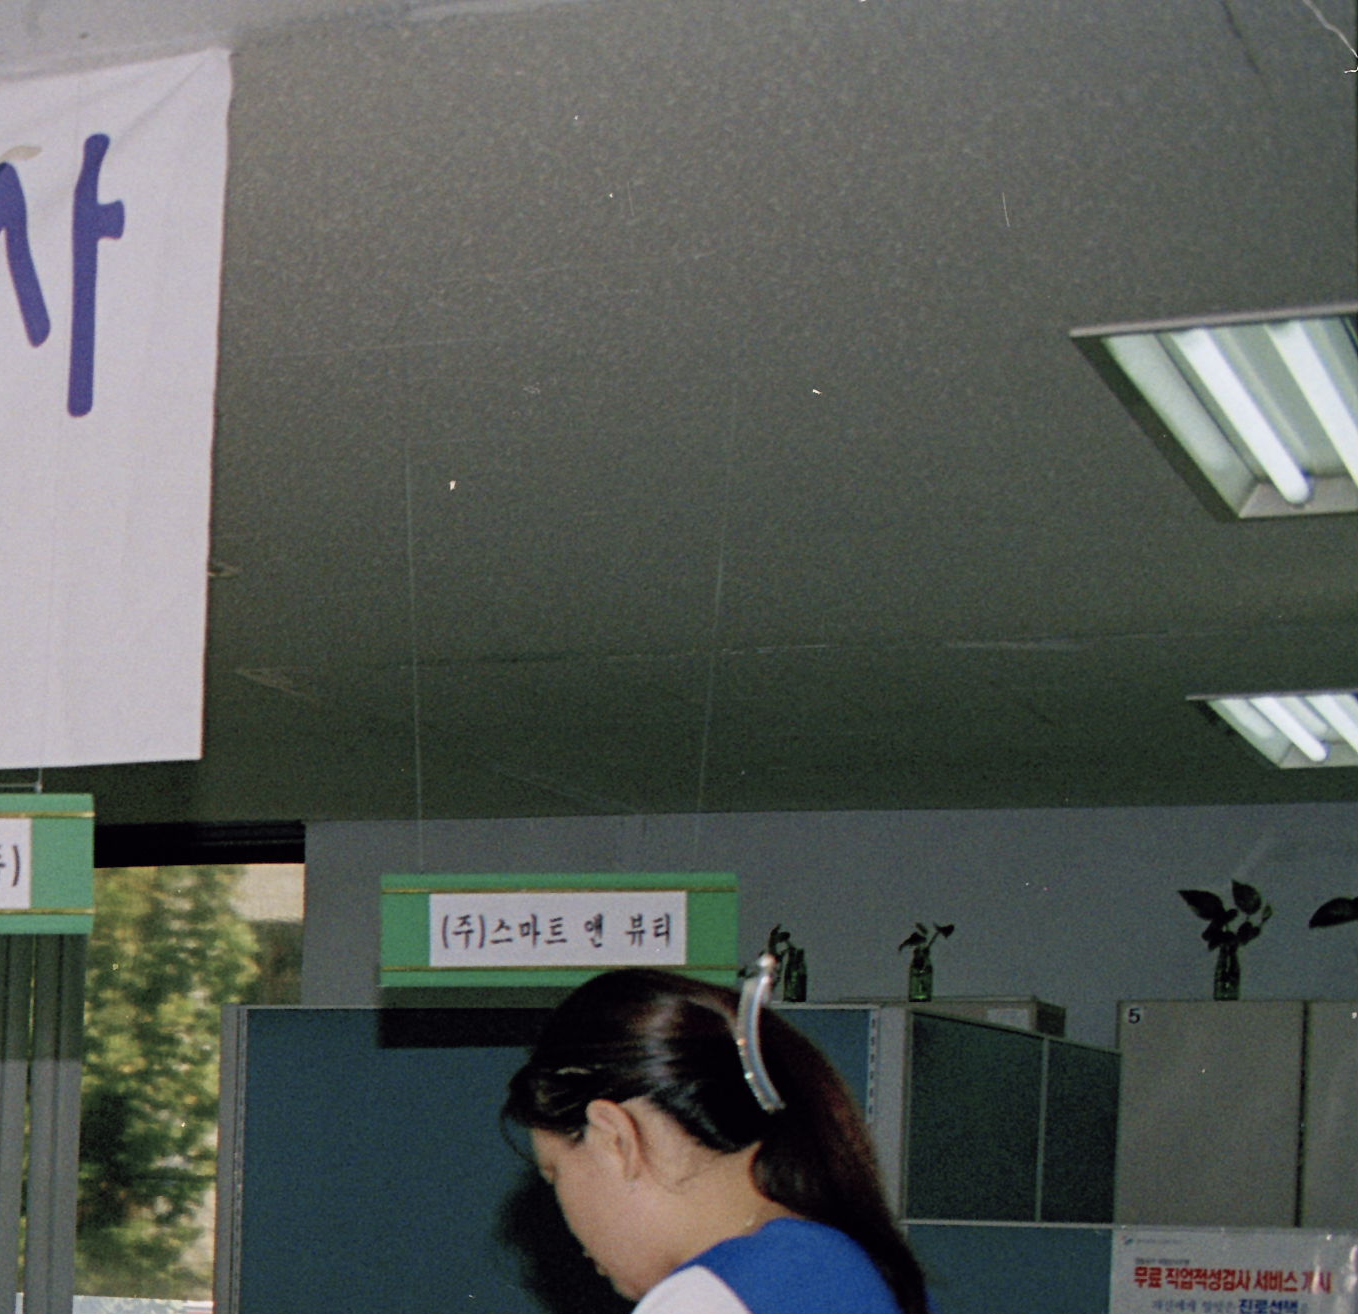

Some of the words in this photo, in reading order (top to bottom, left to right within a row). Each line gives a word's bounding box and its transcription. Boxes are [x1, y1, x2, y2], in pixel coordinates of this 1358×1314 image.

[440, 913, 569, 950] (주)스마트
[583, 913, 605, 948] 앤
[624, 912, 673, 947] 뷰티
[1128, 1007, 1141, 1025] 5
[1134, 1265, 1163, 1289] 무료
[1253, 1270, 1299, 1294] 서비스
